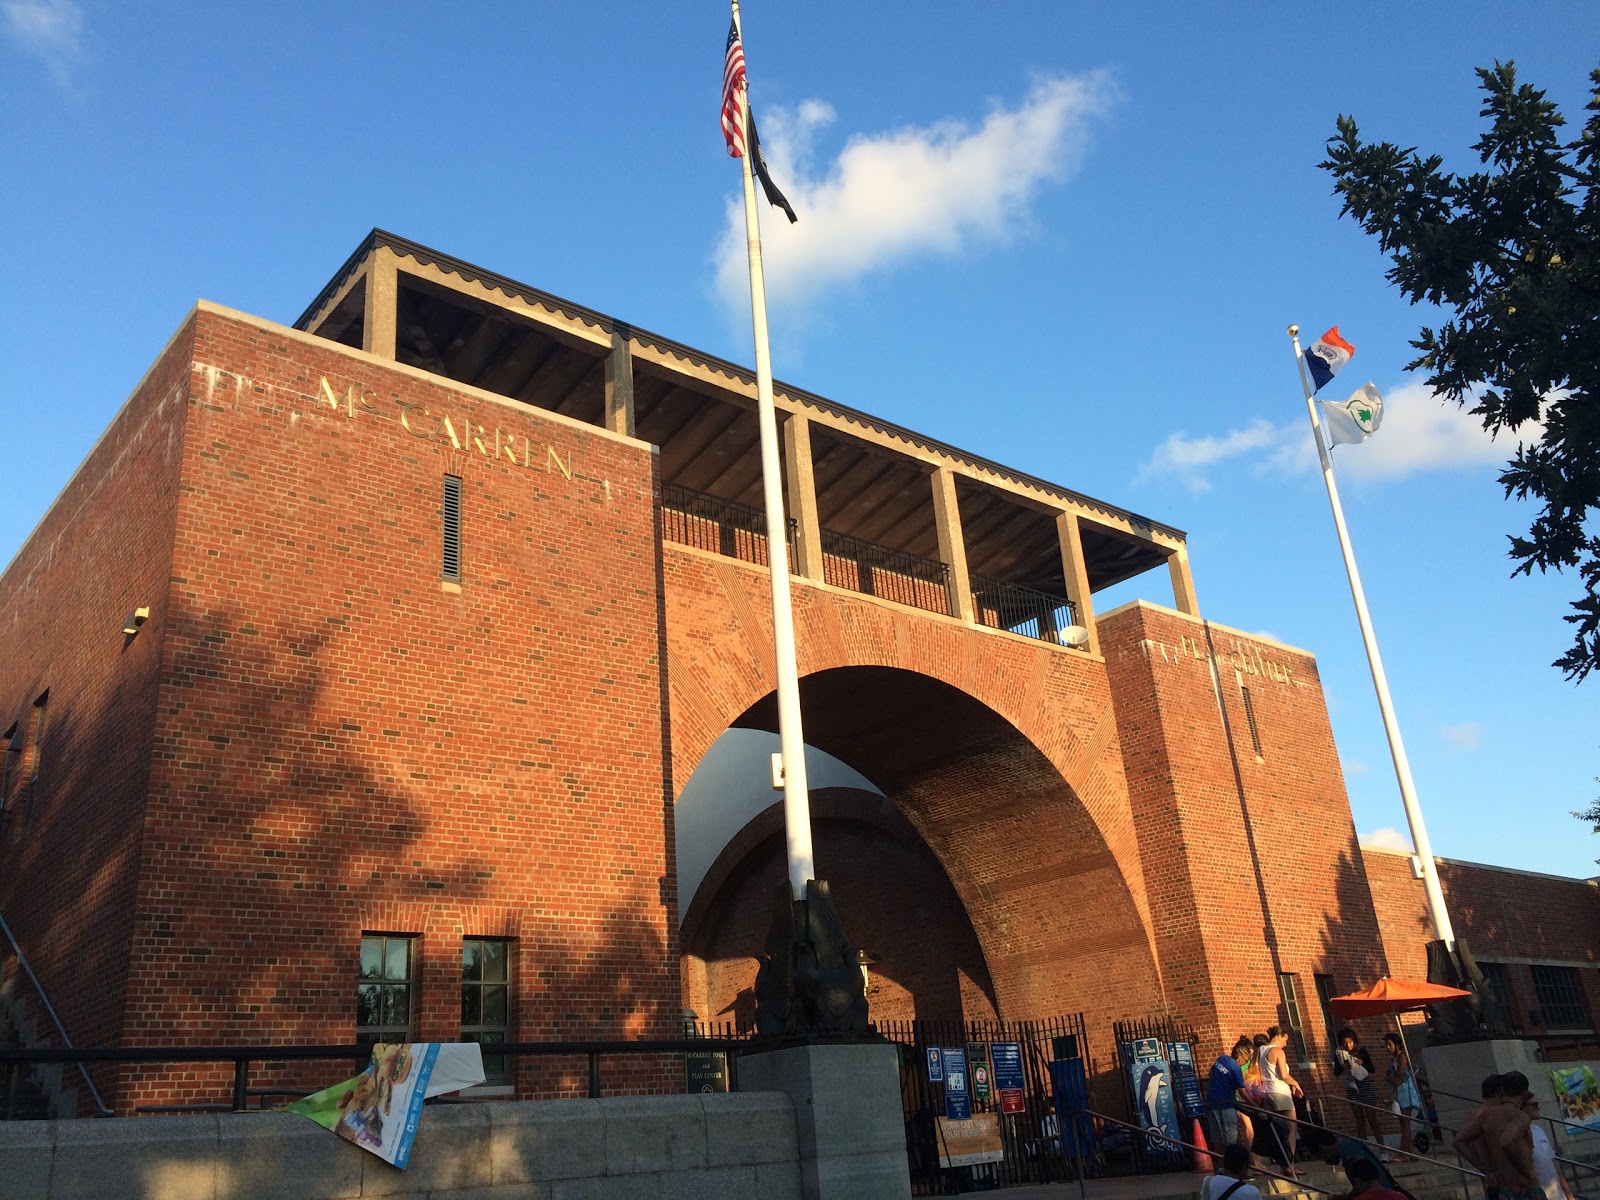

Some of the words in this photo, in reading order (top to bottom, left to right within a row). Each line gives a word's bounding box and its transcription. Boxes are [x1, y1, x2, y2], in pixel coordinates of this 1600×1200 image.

[401, 404, 571, 480] CARREN
[1229, 650, 1297, 687] CENTER
[941, 1121, 960, 1131] WORK
[960, 1119, 974, 1129] OUT
[974, 1118, 991, 1127] WITH
